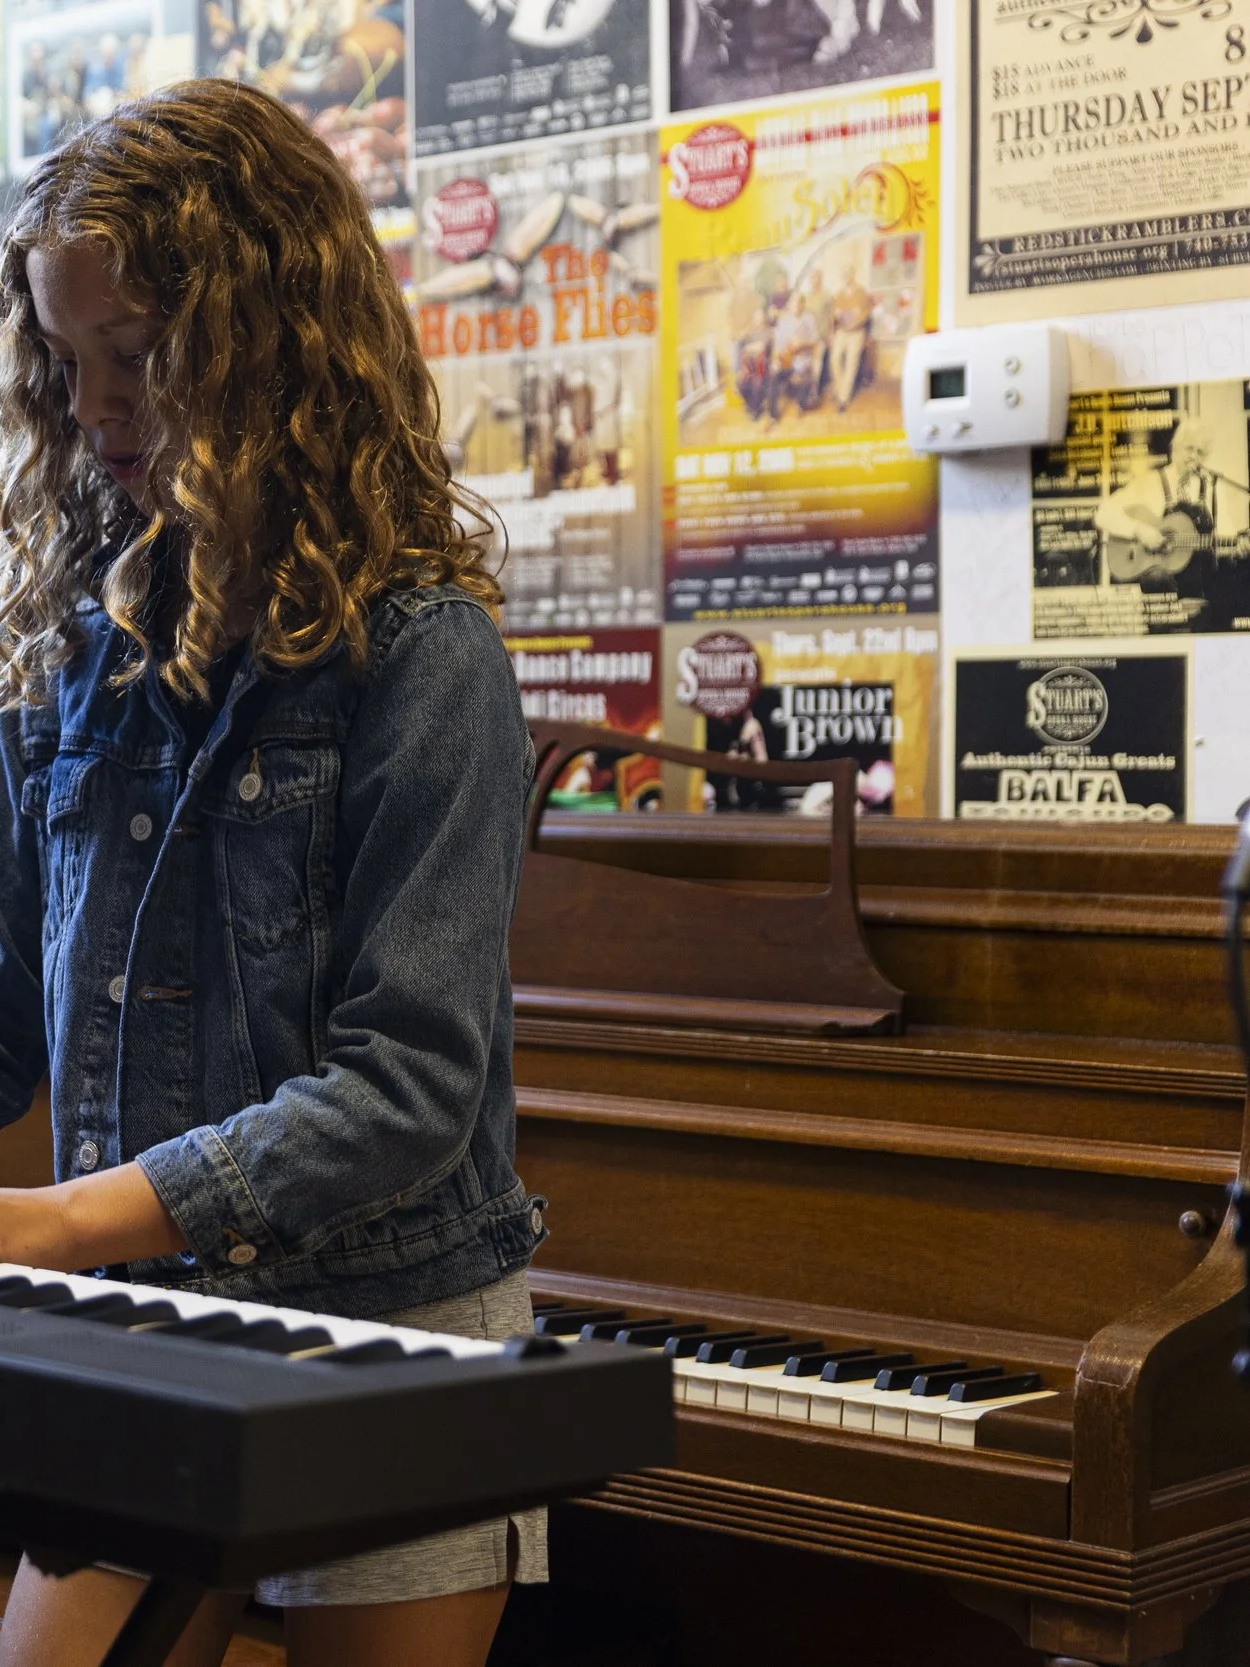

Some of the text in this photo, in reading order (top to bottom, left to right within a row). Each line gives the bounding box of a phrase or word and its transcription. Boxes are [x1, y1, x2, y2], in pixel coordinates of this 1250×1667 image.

[1023, 53, 1095, 77] ADVANCE
[1224, 23, 1247, 64] 8
[1049, 74, 1079, 92] THE
[1083, 66, 1128, 87] DOOR
[991, 84, 1174, 145] THURSDAY
[994, 113, 1239, 164] TWO THOUSAND AND
[1052, 161, 1094, 175] PLEASE
[1096, 155, 1147, 170] SUPPORT
[1177, 142, 1240, 159] SPONSORS
[1013, 208, 1250, 253] REDSTICKRAMBLERS.C
[541, 240, 610, 285] The
[419, 278, 657, 359] Horse Flies
[677, 647, 758, 704] STUART'S
[770, 679, 894, 727] Junior
[1026, 681, 1104, 729] STUART'S
[784, 713, 904, 760] Brown
[961, 751, 1177, 771] Authentic Cajun Greats
[999, 769, 1128, 803] BALFA
